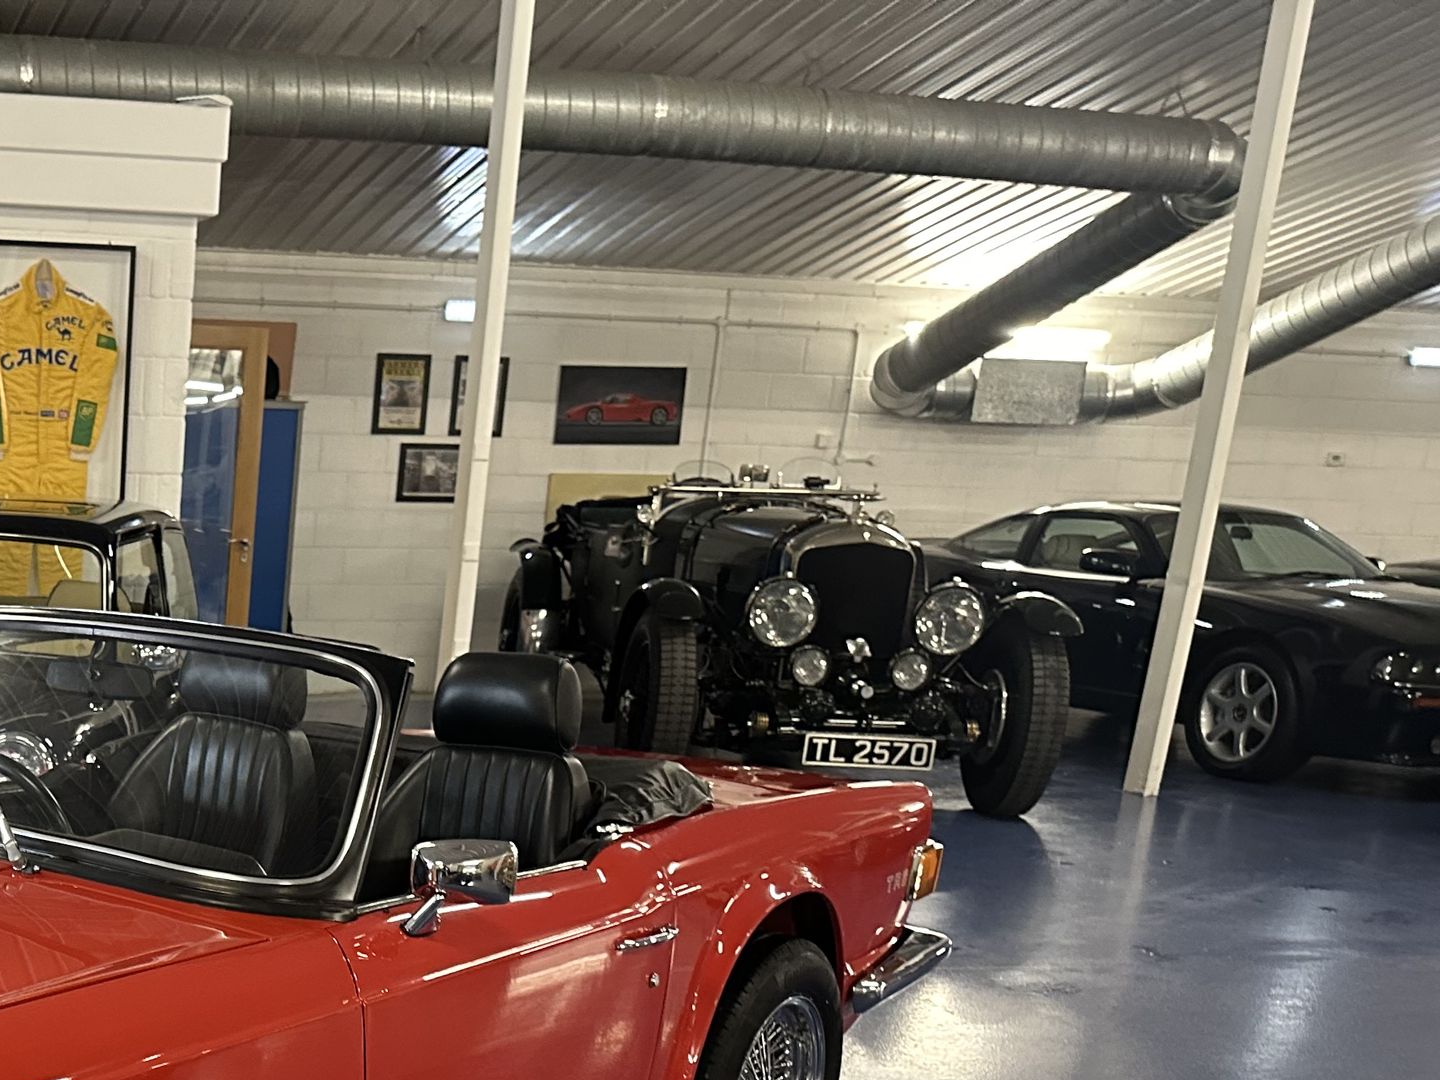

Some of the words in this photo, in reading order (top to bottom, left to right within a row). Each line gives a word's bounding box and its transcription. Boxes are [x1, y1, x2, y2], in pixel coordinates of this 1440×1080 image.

[45, 316, 86, 331] CAMEL
[0, 348, 79, 372] CAMEL
[812, 738, 846, 763] TL
[852, 740, 929, 766] 2570
